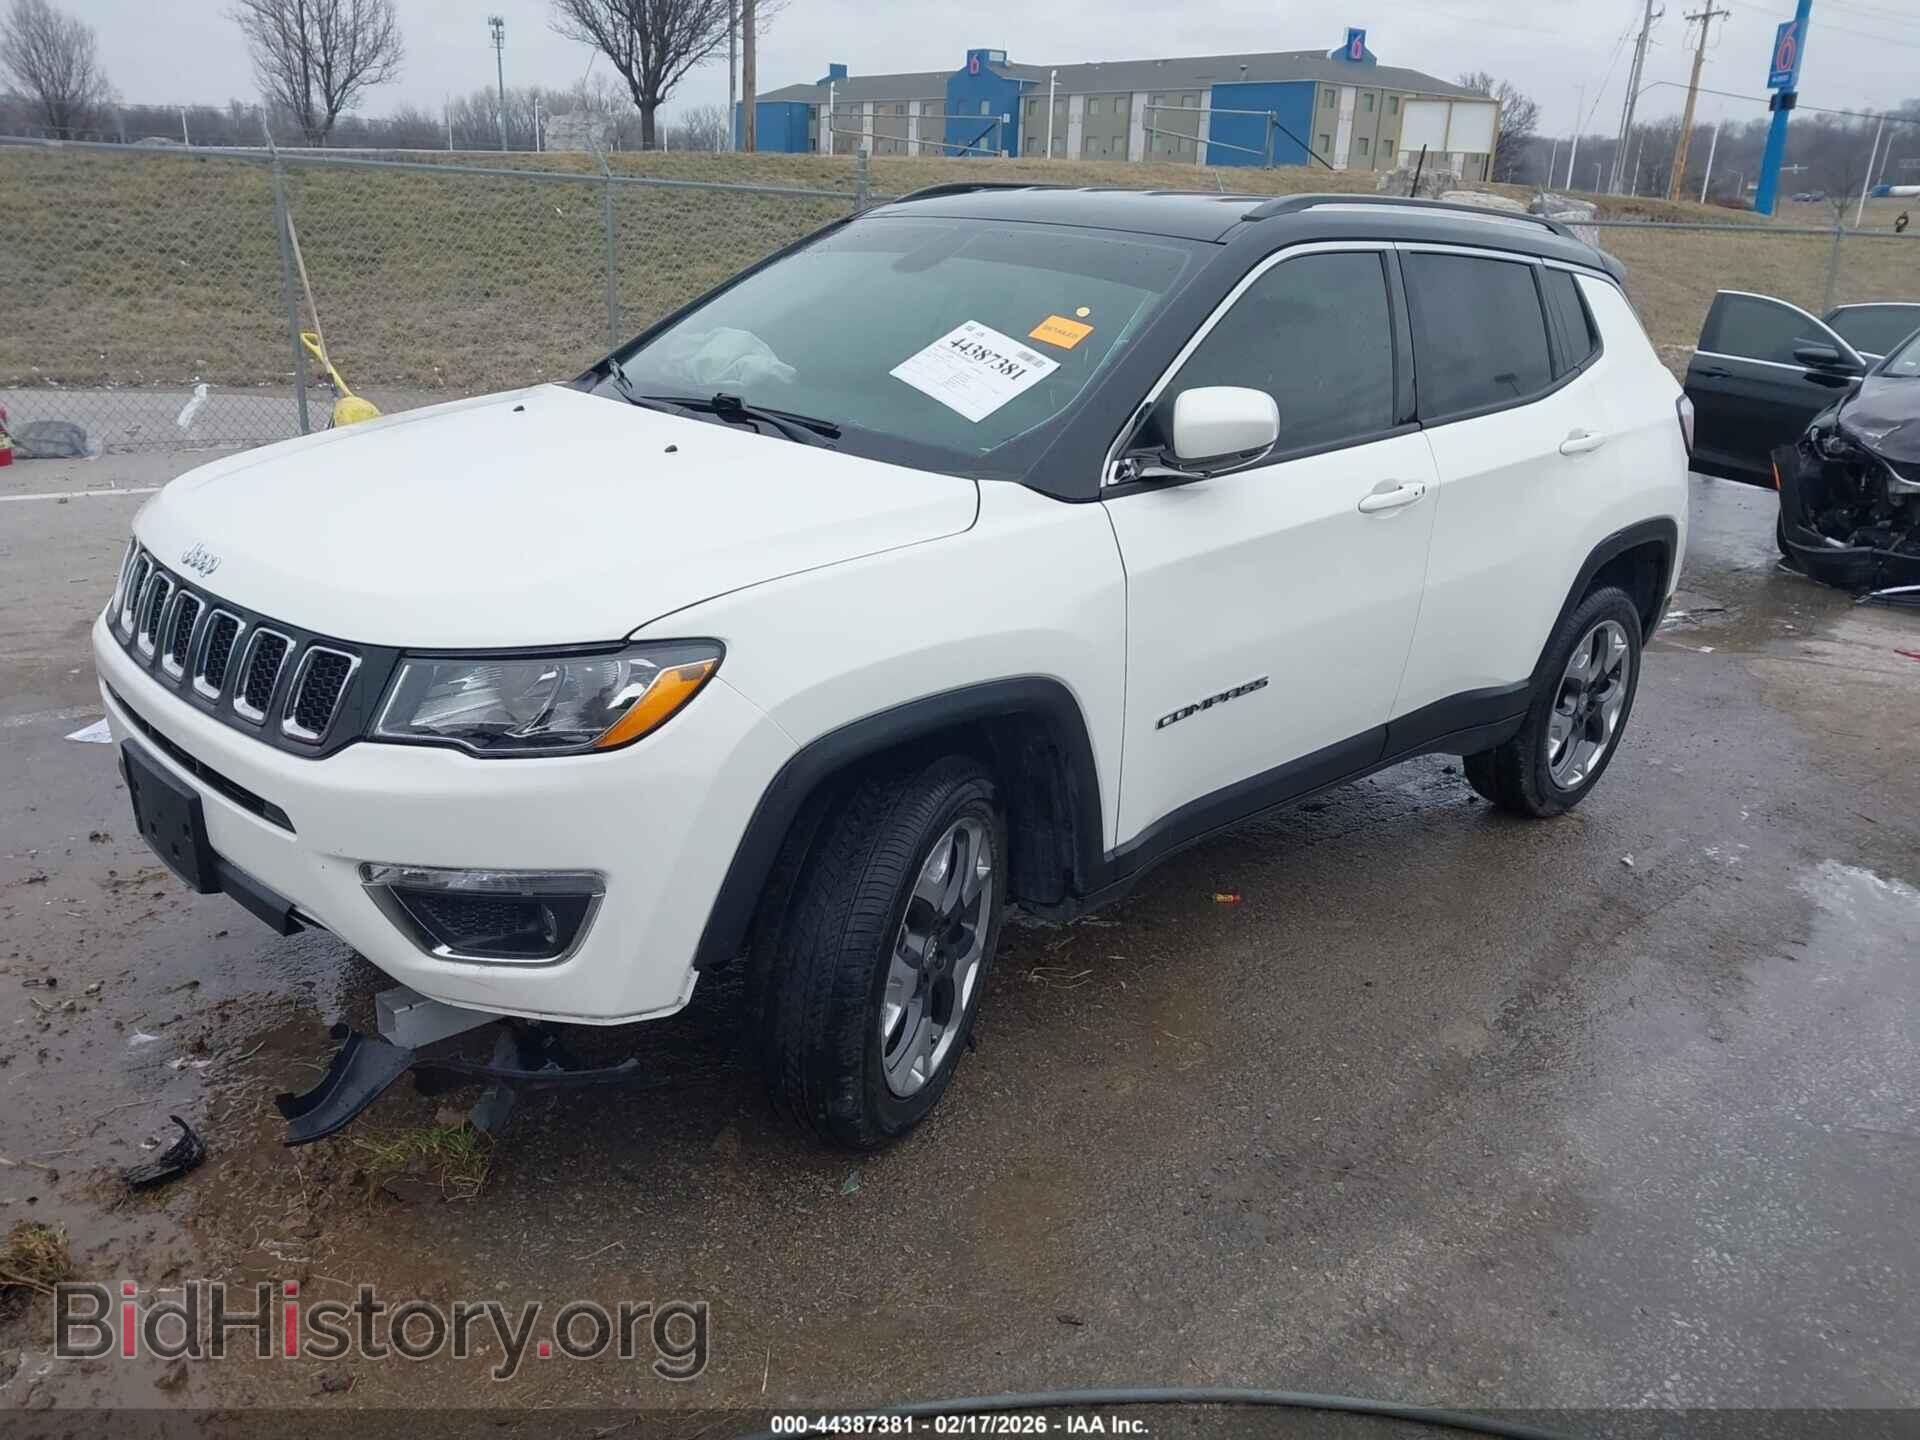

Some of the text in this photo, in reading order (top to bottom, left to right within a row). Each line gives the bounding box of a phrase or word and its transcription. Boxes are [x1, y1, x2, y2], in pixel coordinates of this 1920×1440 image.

[1351, 34, 1362, 59] 6
[1775, 21, 1799, 72] 6
[950, 337, 1029, 381] 44387381
[181, 543, 221, 578] Jeep
[1155, 676, 1269, 730] COMPASS
